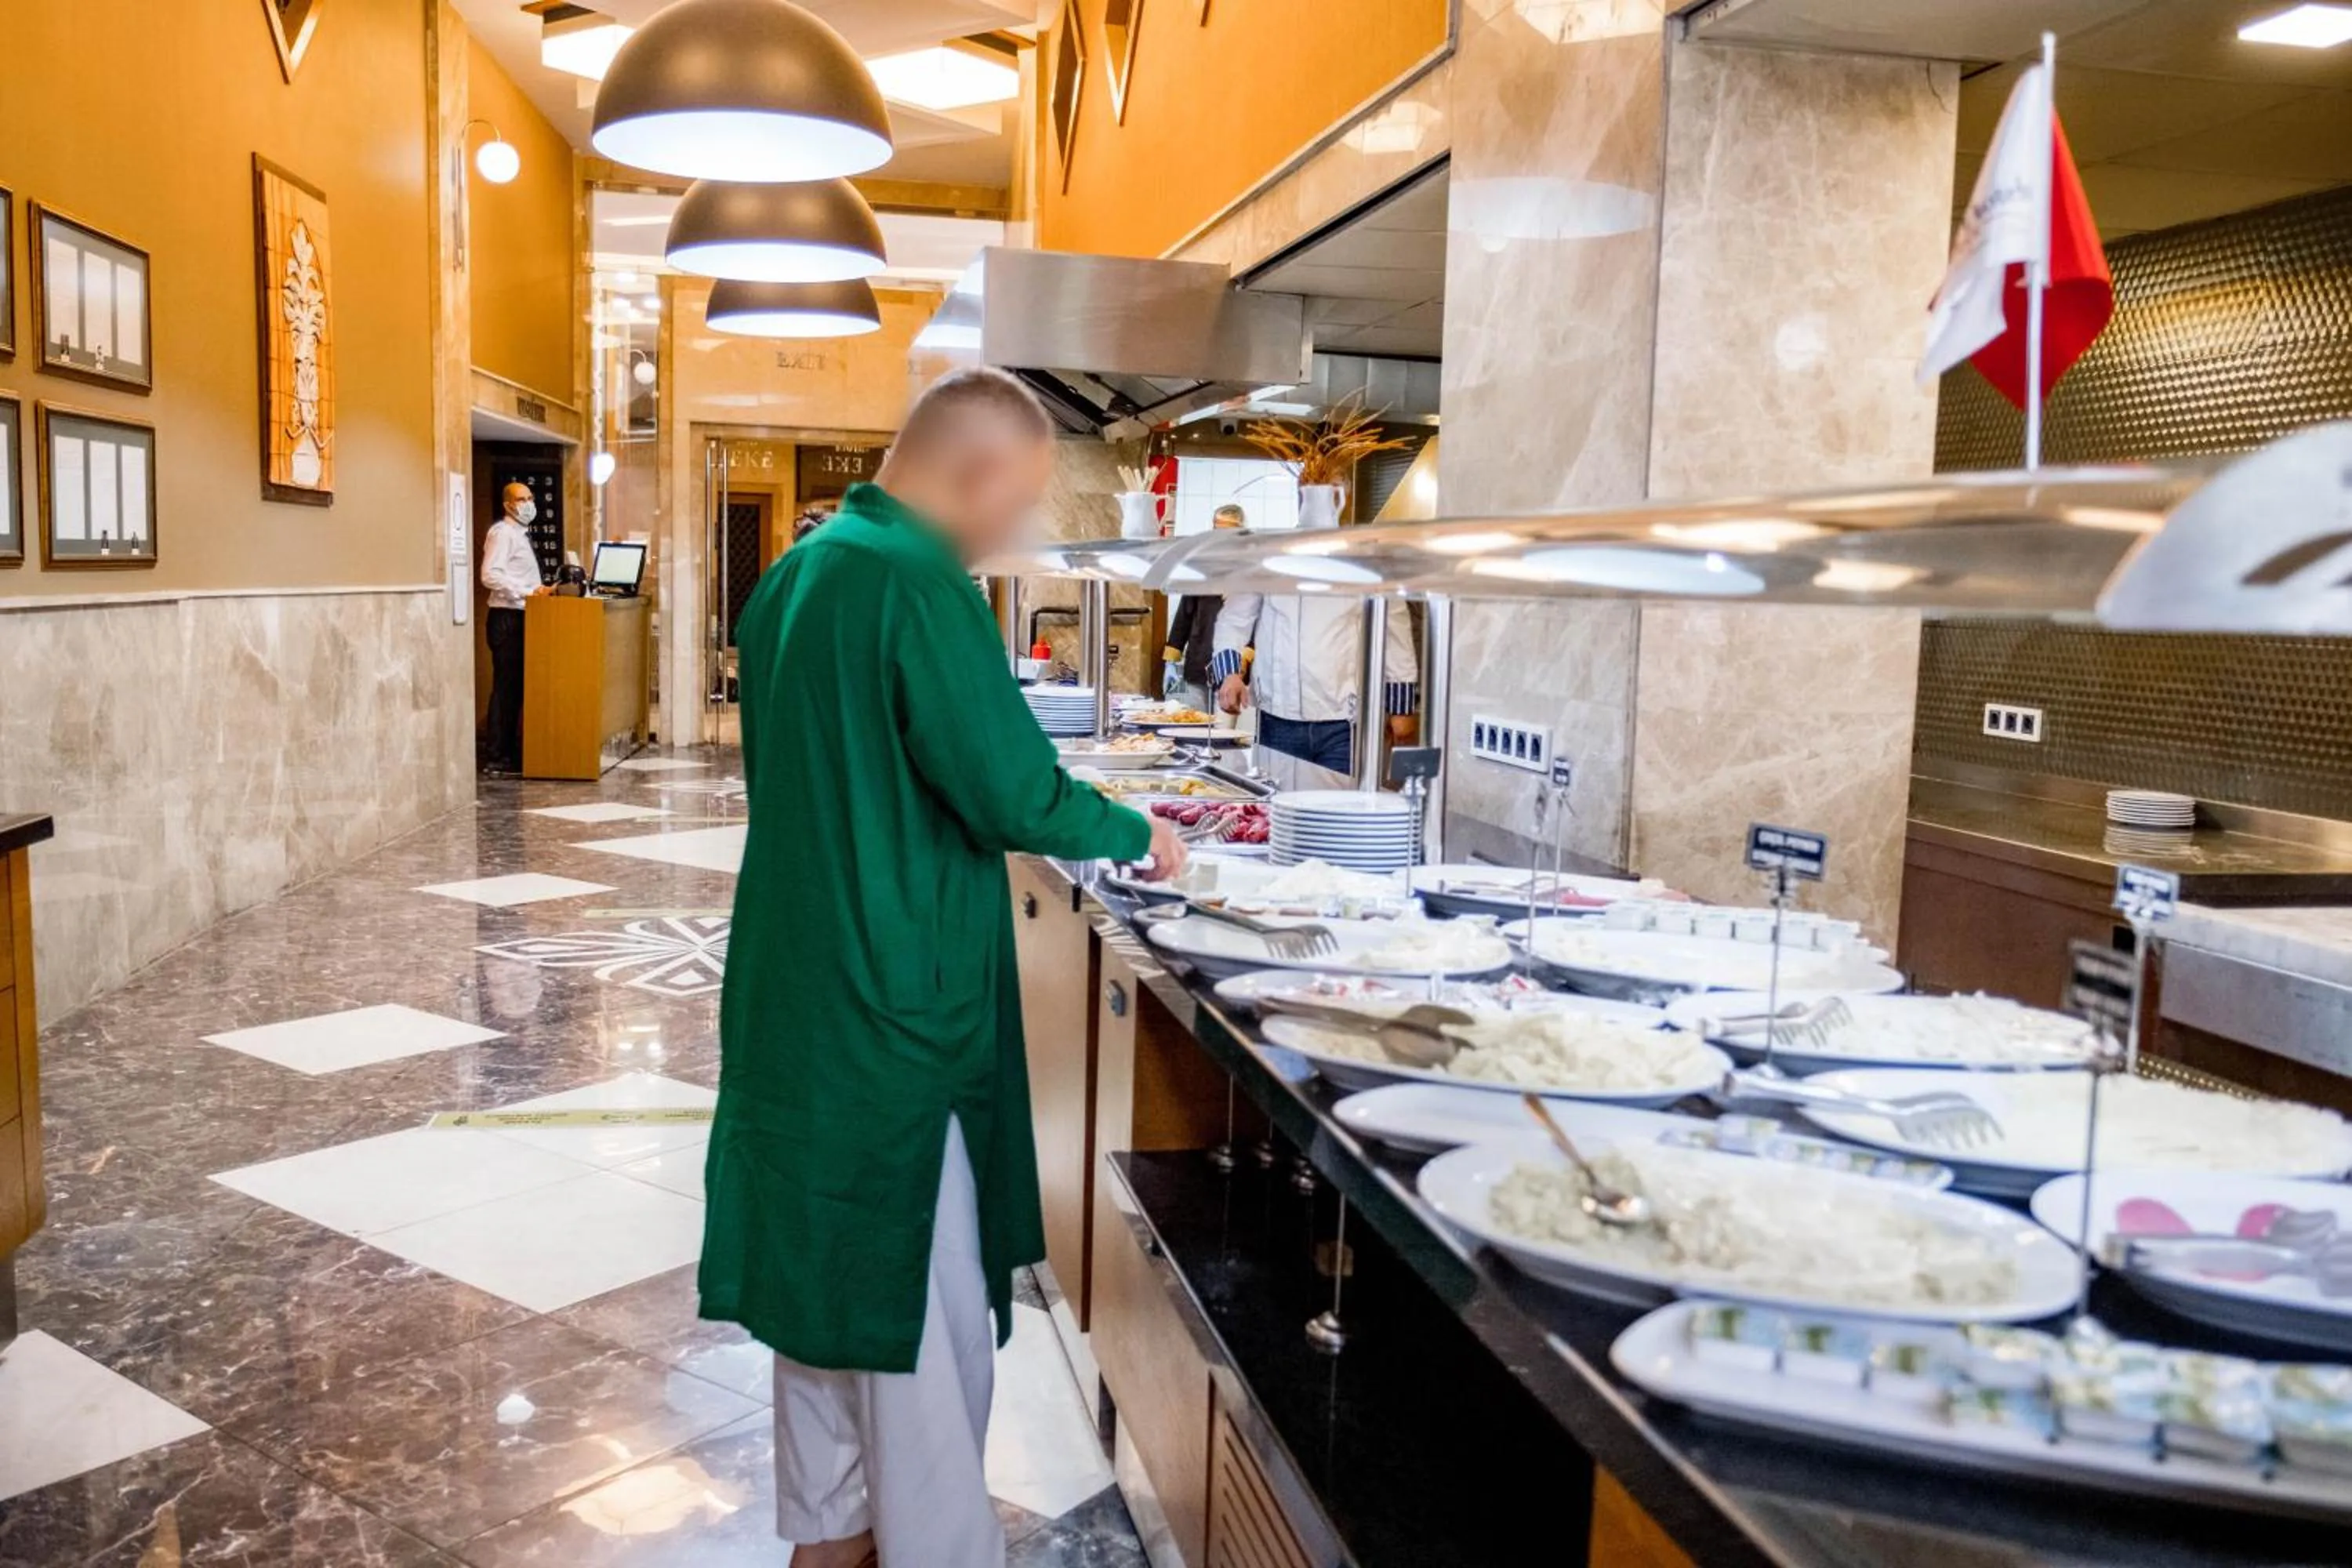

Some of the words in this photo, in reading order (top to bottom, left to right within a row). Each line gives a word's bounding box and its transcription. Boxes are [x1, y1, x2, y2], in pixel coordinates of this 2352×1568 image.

[528, 476, 535, 485] 2
[545, 476, 553, 486] 3
[543, 524, 556, 534] 12
